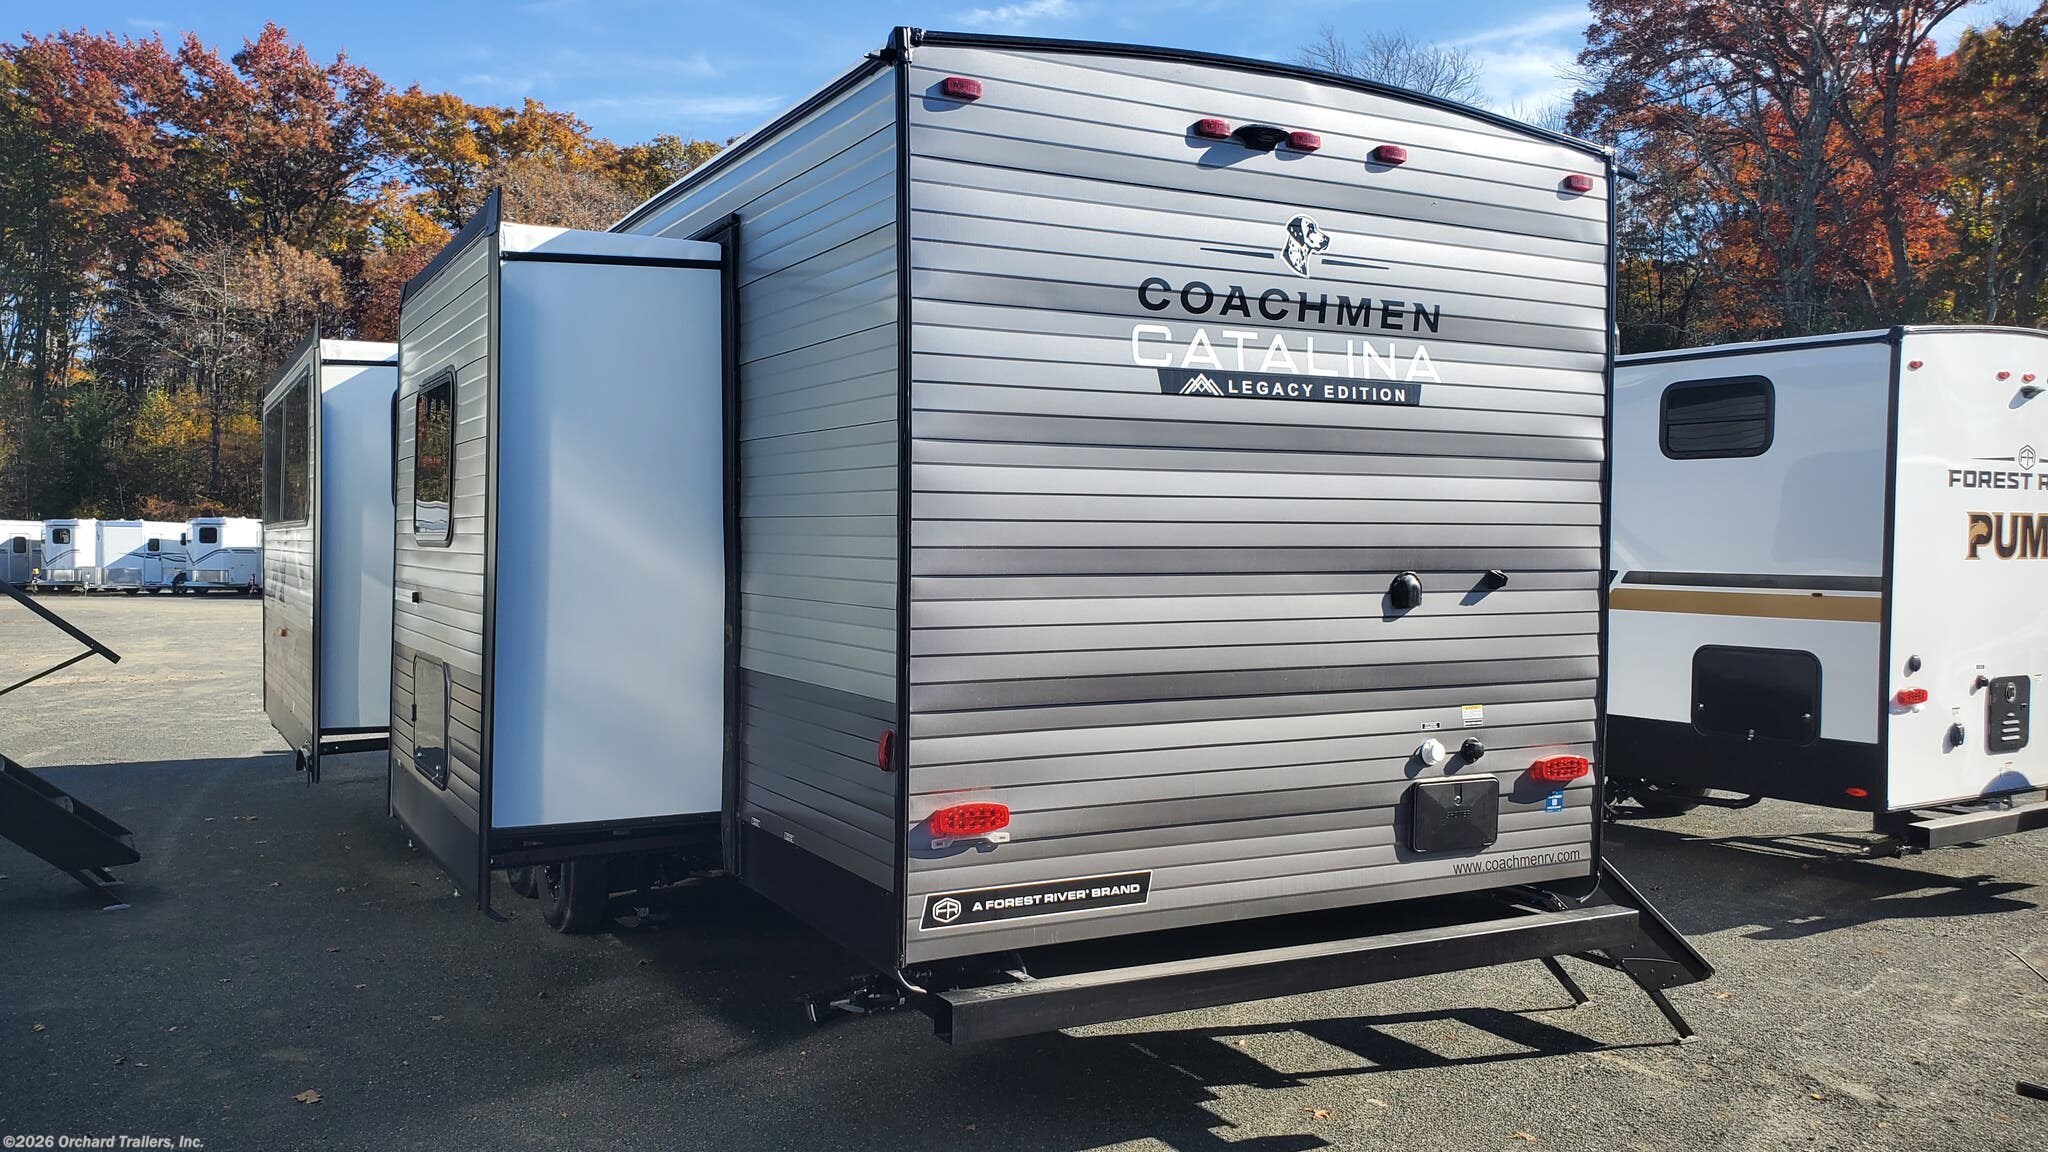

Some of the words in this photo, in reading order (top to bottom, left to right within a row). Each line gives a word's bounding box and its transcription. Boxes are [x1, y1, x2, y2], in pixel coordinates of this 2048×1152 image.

[1137, 277, 1441, 333] COACHMEN
[1131, 324, 1442, 383] CATALINA
[1228, 379, 1313, 398] LEGACY
[1324, 385, 1406, 402] EDITION
[1948, 469, 2033, 490] FOREST
[1452, 848, 1581, 875] www.coachmenrv.com
[971, 901, 984, 912] A
[985, 894, 1042, 910] FOREST
[1091, 883, 1141, 898] BRAND
